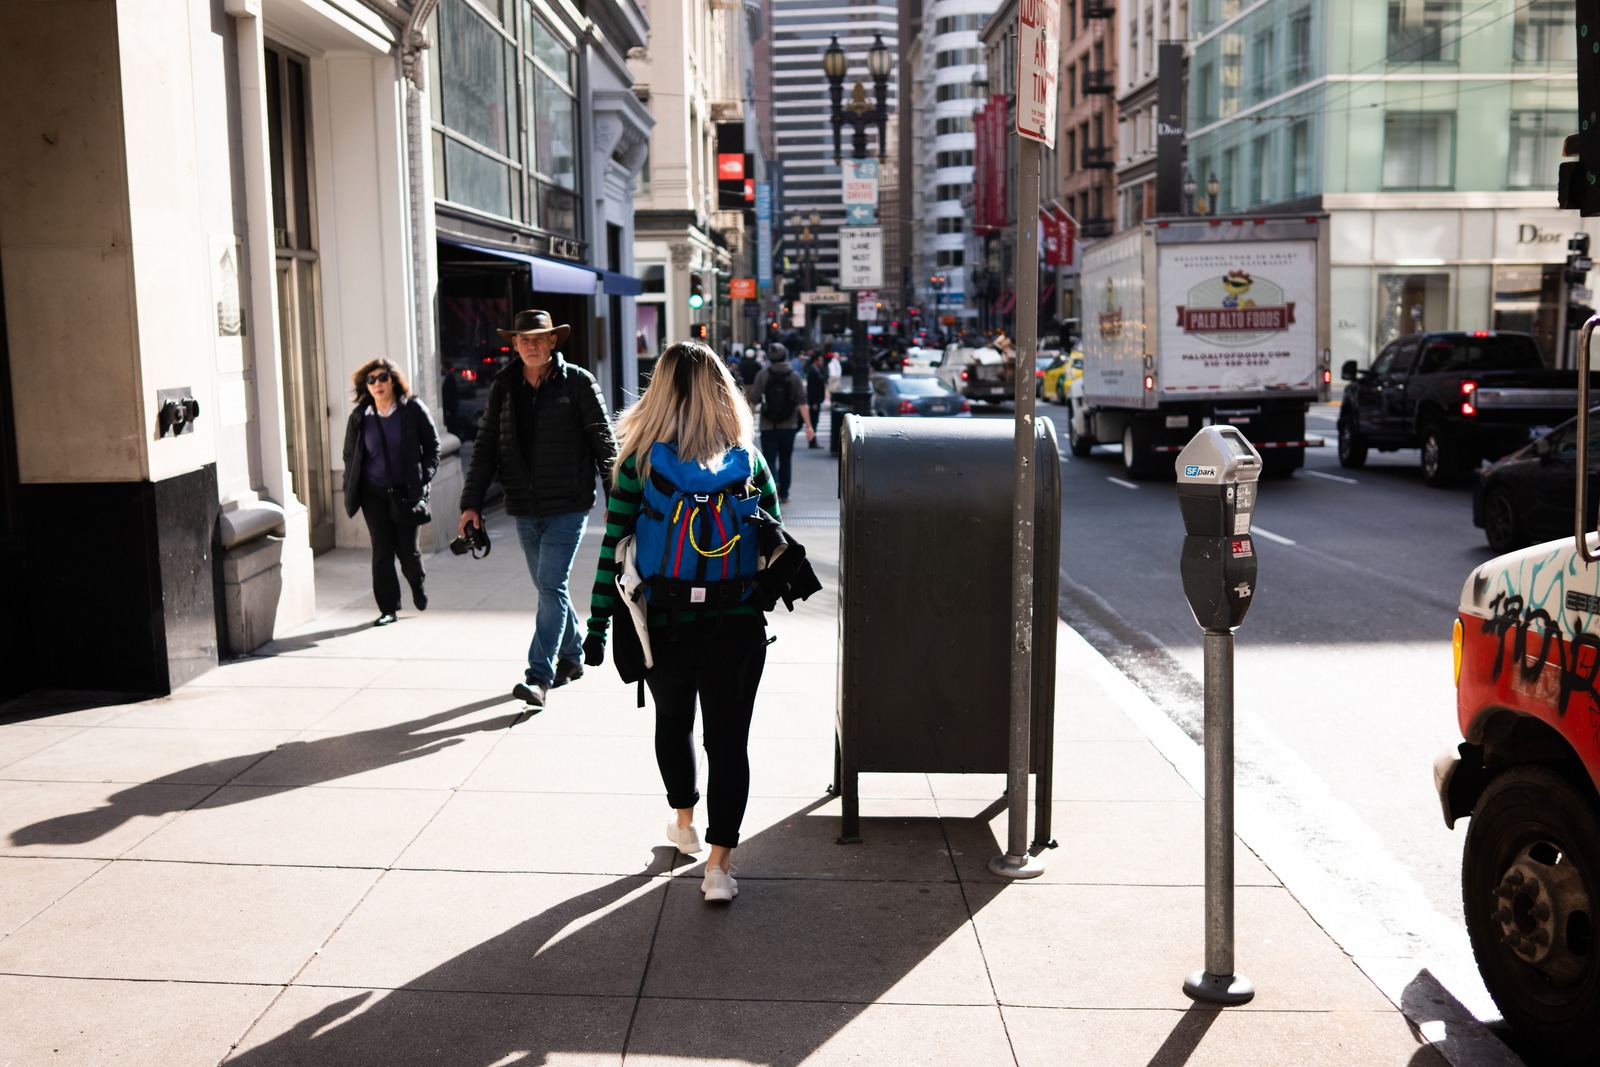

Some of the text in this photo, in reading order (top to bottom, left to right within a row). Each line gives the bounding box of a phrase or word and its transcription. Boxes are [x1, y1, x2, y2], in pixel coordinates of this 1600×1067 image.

[1158, 122, 1183, 135] Dior
[859, 163, 876, 174] 49
[841, 231, 882, 239] TOW-AWAY
[1517, 223, 1562, 243] Dior
[1191, 310, 1280, 329] PALO ALTO FOODS
[1182, 351, 1290, 360] PALOALTOFOODS.COM
